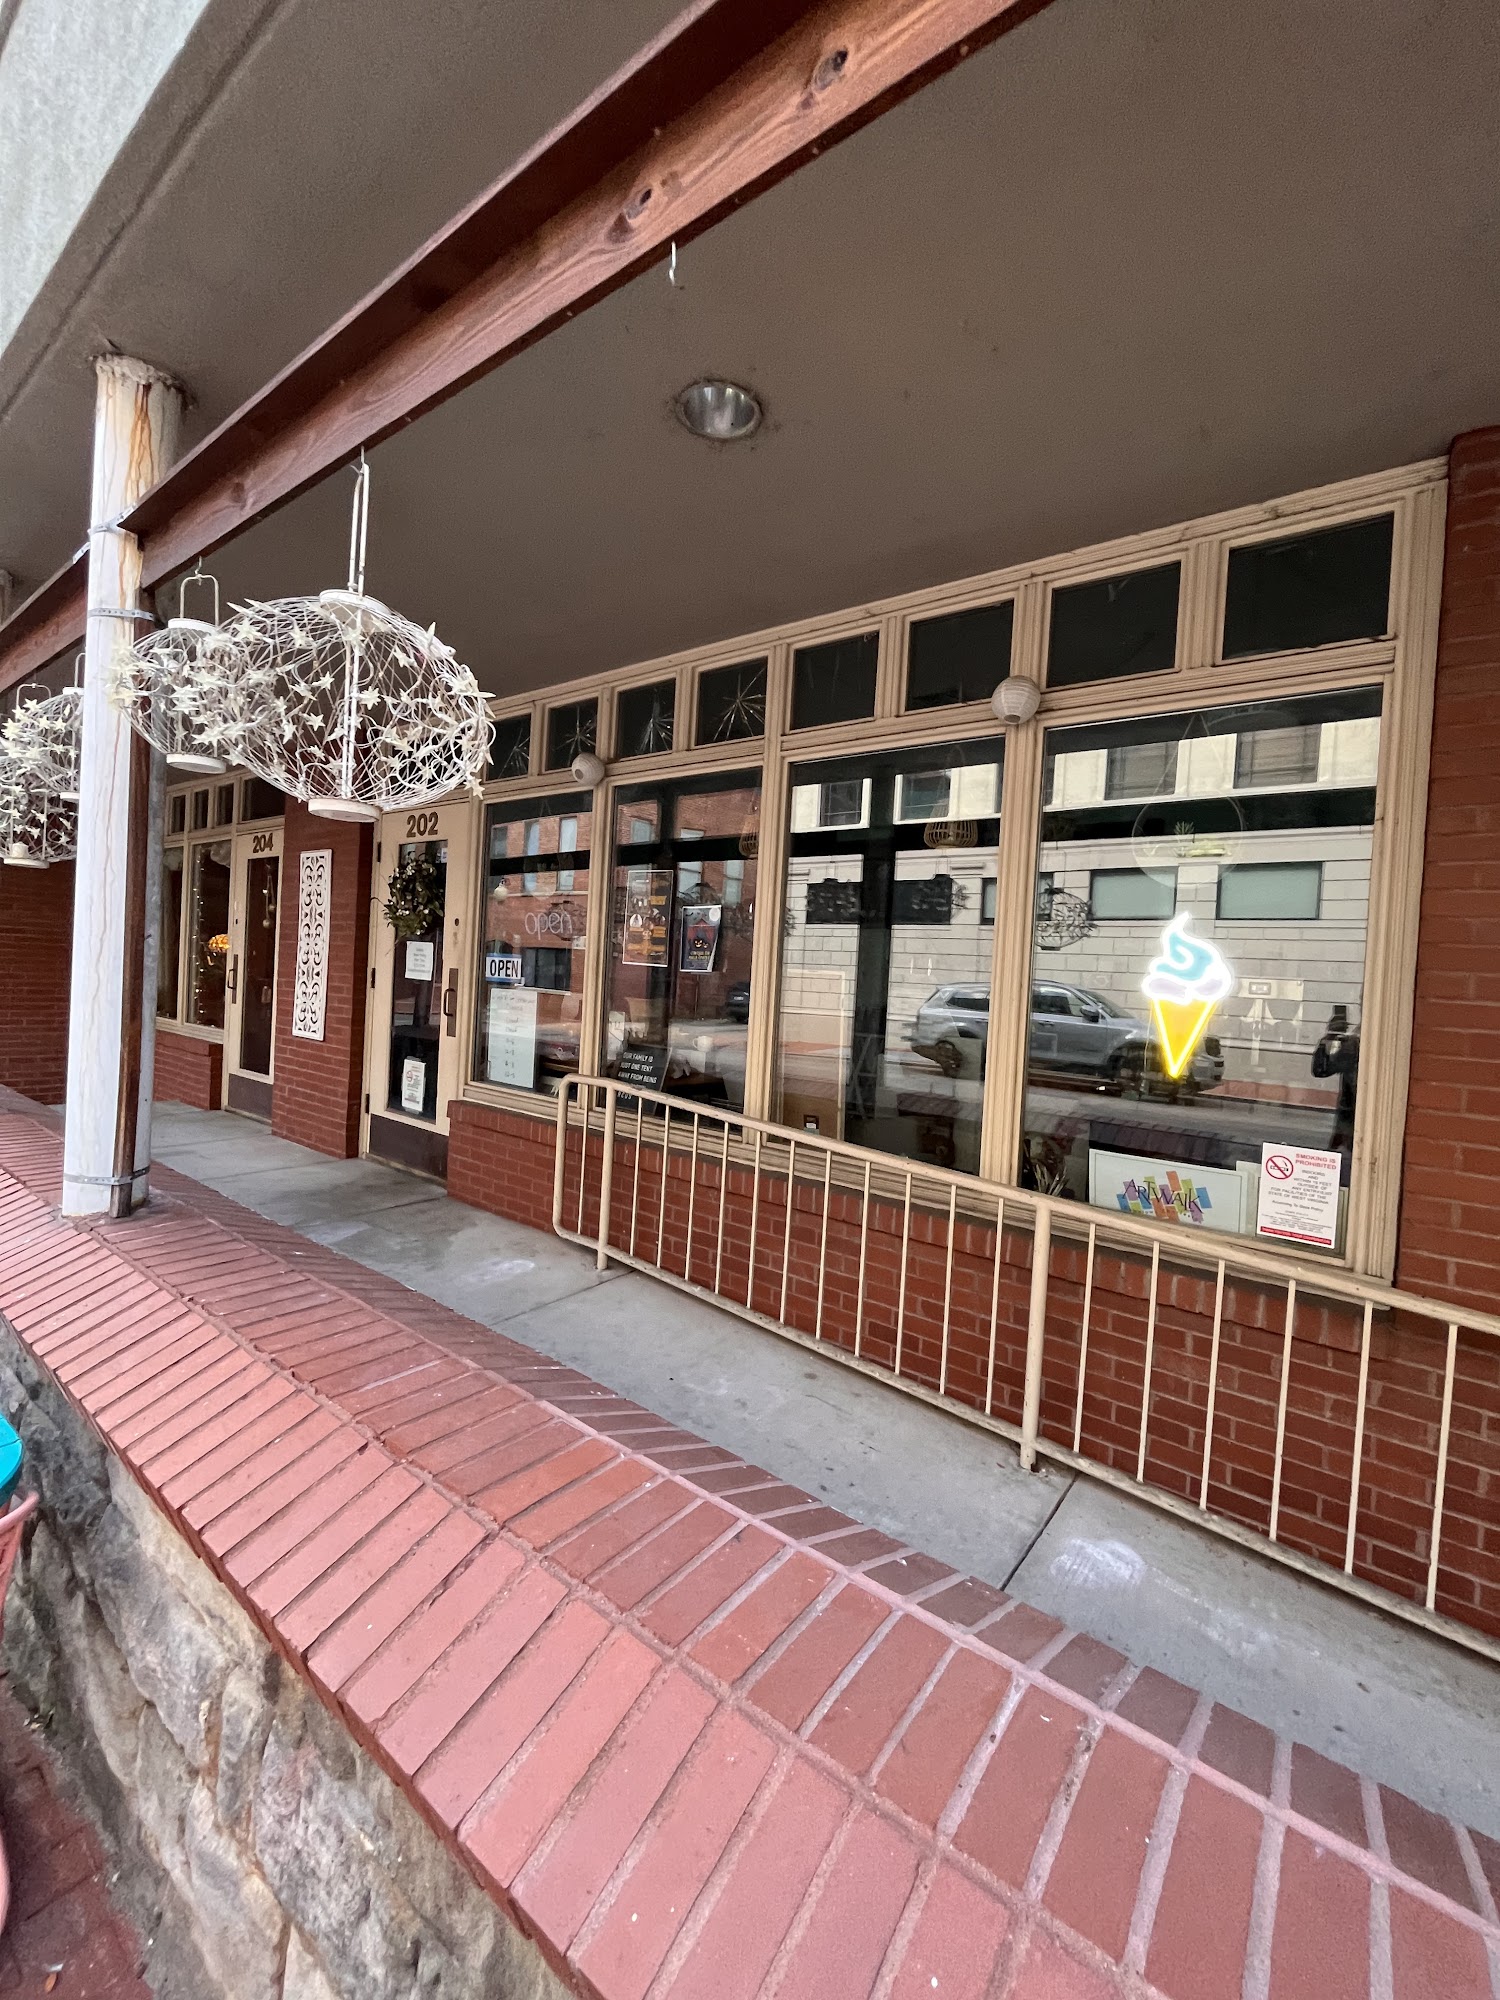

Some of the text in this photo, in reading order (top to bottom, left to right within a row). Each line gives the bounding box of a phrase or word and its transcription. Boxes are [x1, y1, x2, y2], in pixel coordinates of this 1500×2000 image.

[406, 811, 439, 838] 202
[252, 832, 274, 854] 204
[525, 911, 573, 940] open
[489, 959, 519, 978] OPEN
[623, 1052, 633, 1060] OUR
[633, 1053, 648, 1062] FAMILY
[631, 1063, 641, 1071] ONE
[641, 1064, 653, 1072] TENT
[630, 1072, 643, 1081] FROM
[643, 1075, 657, 1084] BEING
[1295, 1153, 1328, 1163] SMOKING
[1295, 1159, 1337, 1170] PROHIBITED
